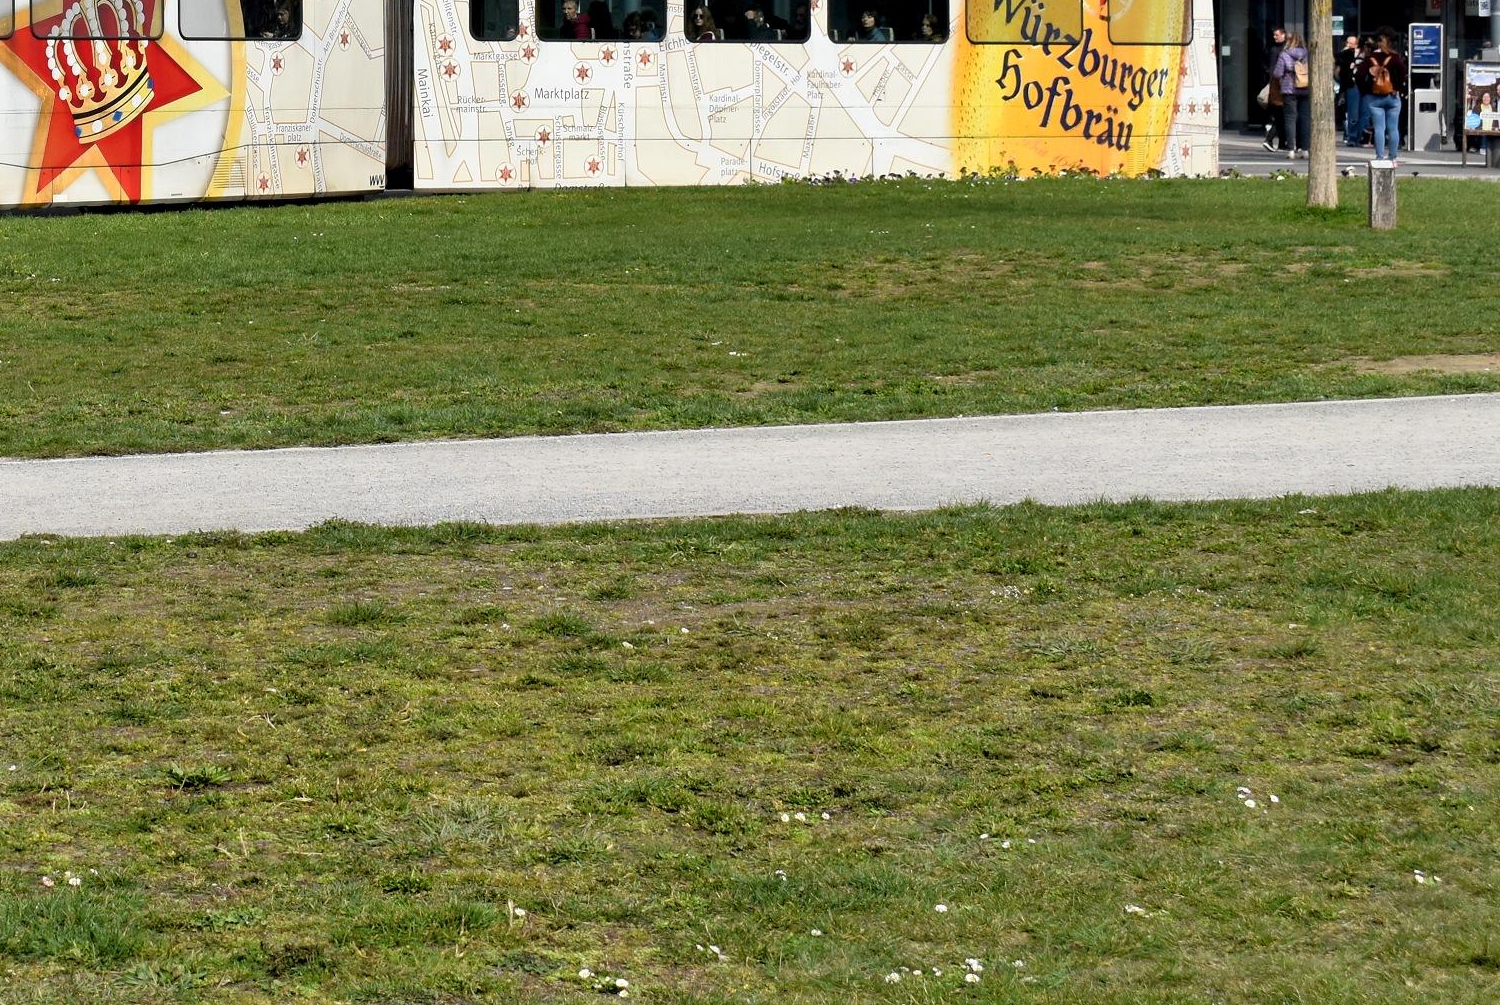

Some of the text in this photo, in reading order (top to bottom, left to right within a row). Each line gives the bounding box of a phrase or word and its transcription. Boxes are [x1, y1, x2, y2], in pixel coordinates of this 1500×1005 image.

[417, 68, 434, 119] Mainkai
[534, 88, 590, 101] Marktplatz
[708, 95, 741, 104] Kardinal-
[995, 48, 1134, 152] Hofbräu
[708, 115, 727, 124] Platz
[720, 157, 748, 166] Parade-
[720, 167, 739, 176] platz
